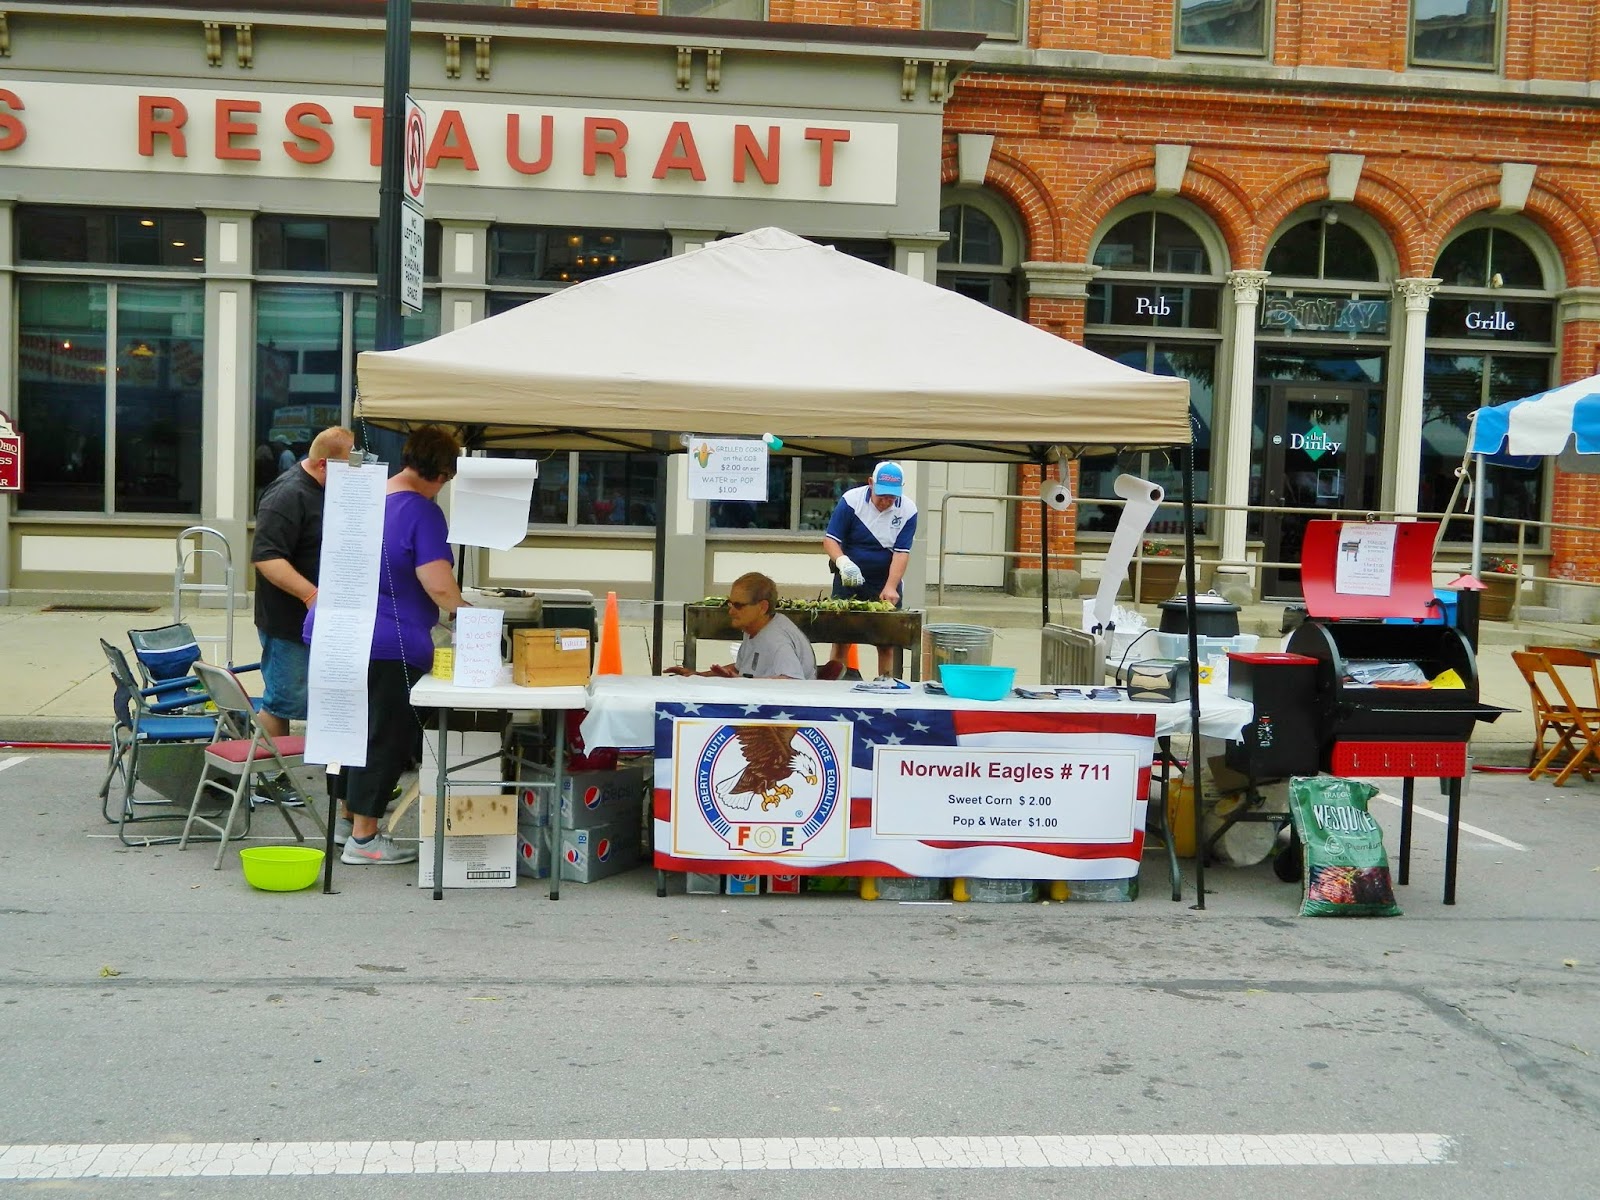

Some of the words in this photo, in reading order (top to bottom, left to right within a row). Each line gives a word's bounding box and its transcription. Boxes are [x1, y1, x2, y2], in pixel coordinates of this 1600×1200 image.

[138, 94, 851, 188] RESTAURANT
[1135, 295, 1171, 316] Pub
[1465, 311, 1515, 331] Grille
[1312, 409, 1324, 419] 19
[1290, 432, 1341, 456] Dinky
[1311, 432, 1322, 441] the
[715, 445, 744, 453] GRILLED
[745, 445, 764, 453] CORN
[718, 486, 737, 494] $1.00
[703, 732, 726, 763] TRUTH
[804, 728, 832, 763] JUSTICE
[820, 769, 836, 817] EQUALITY
[899, 760, 982, 778] Norwalk
[988, 762, 1054, 783] Eagles
[1060, 763, 1073, 780] #
[1078, 764, 1110, 781] 711
[699, 769, 714, 812] LIBERTY
[948, 794, 982, 805] Sweet
[985, 795, 1013, 806] Corn
[1028, 796, 1052, 806] 2.00
[952, 815, 975, 828] Pop
[977, 816, 986, 826] &
[989, 816, 1022, 827] Water
[1028, 817, 1058, 828] $1.00
[578, 835, 587, 845] 18
